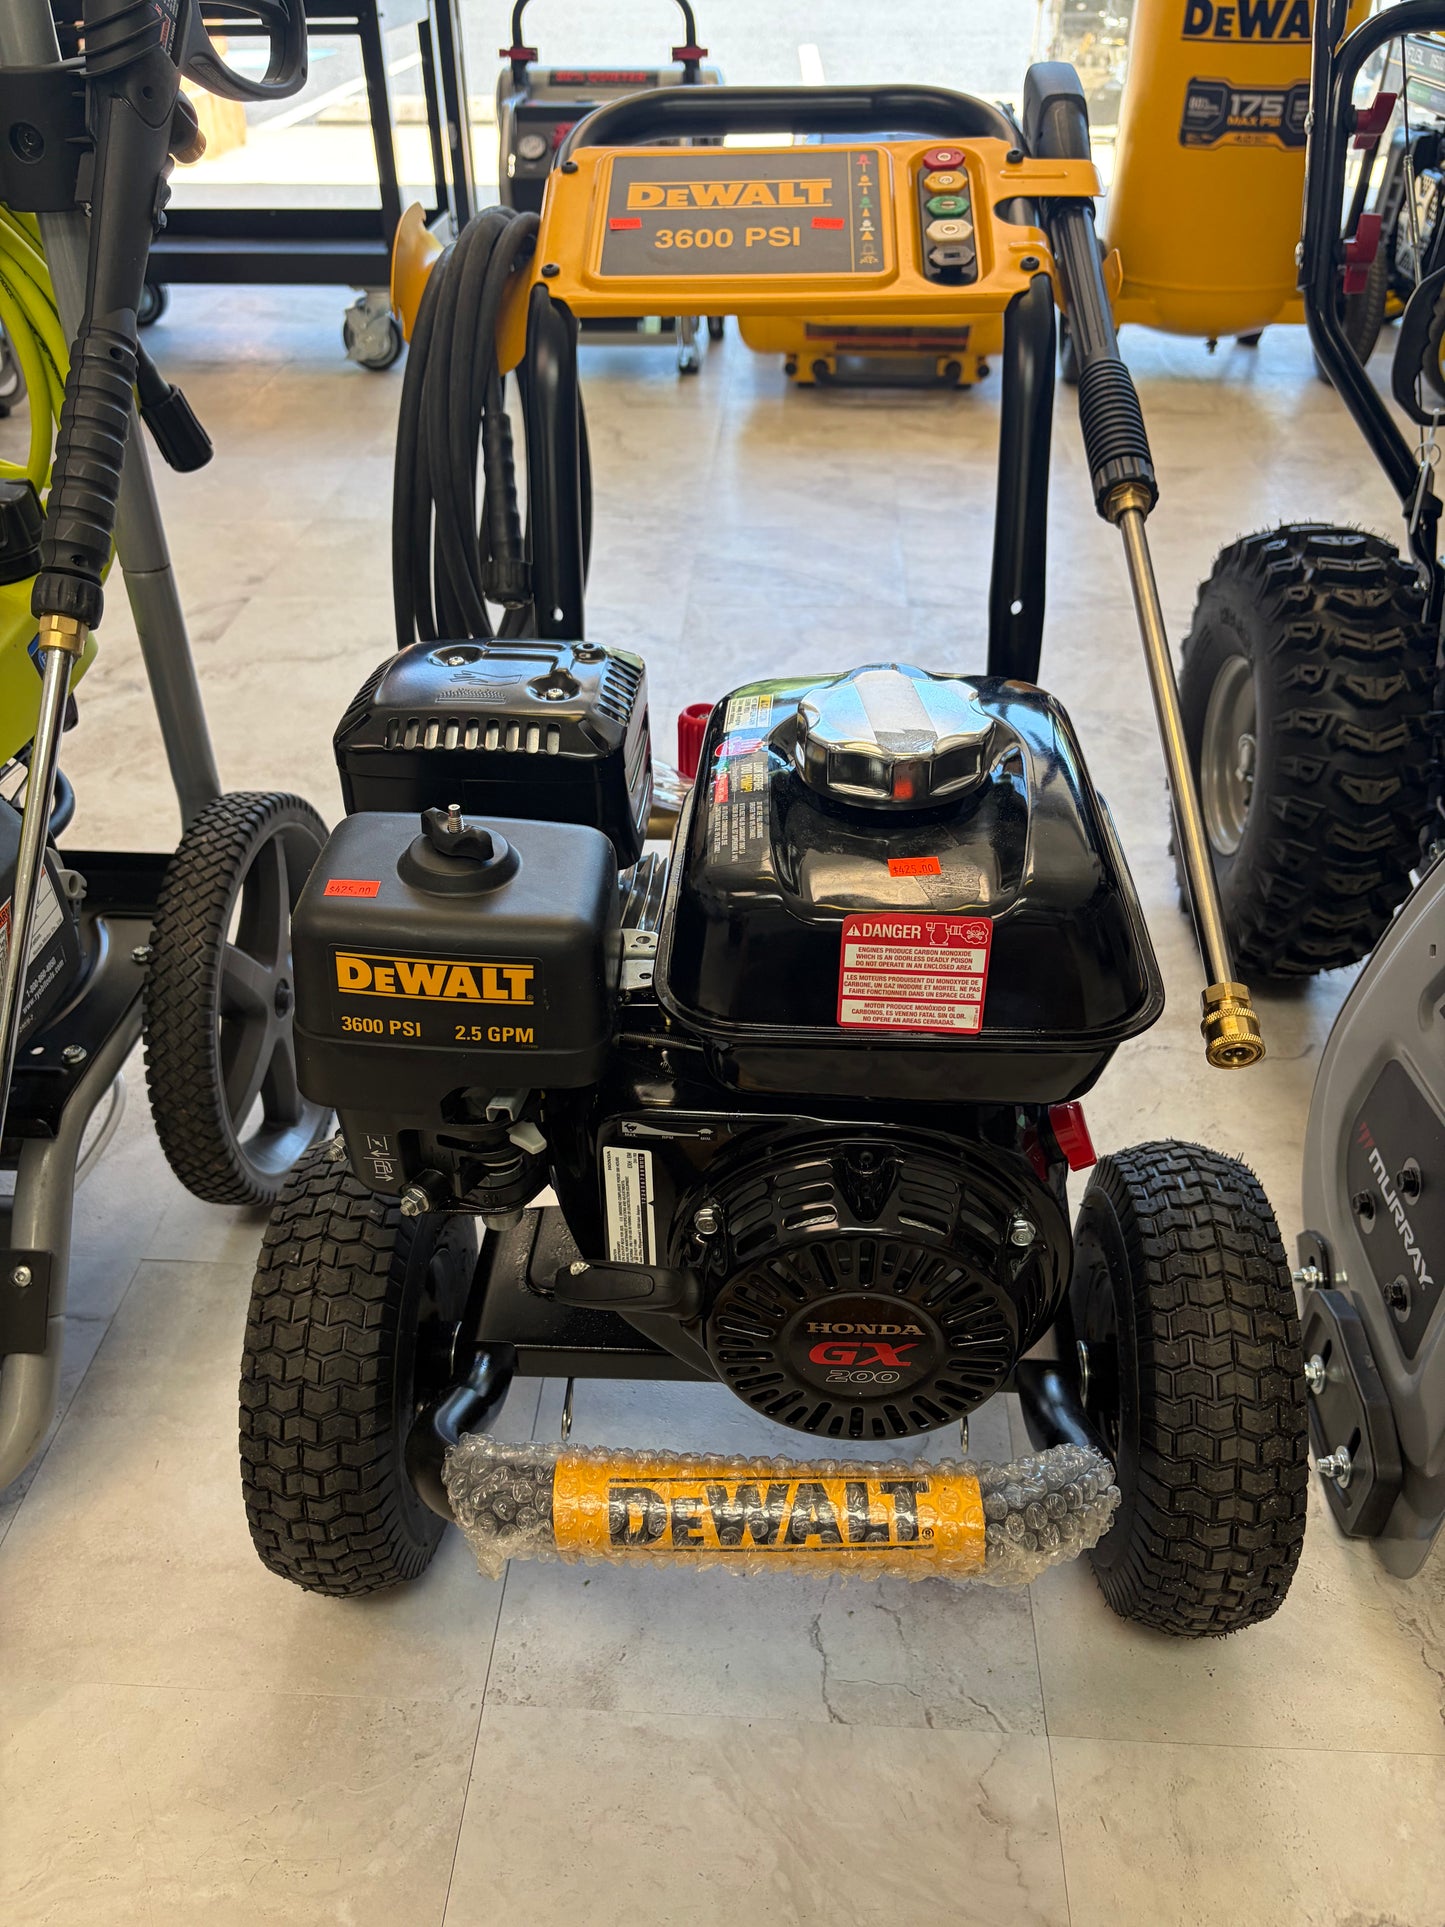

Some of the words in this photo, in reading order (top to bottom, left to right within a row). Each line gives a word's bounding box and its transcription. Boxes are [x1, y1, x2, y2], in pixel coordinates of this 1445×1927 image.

[1183, 0, 1311, 38] DEWA
[1231, 95, 1285, 117] 175
[1227, 116, 1258, 126] MAX
[1260, 117, 1282, 127] PSI
[627, 181, 832, 207] DEWALT
[654, 229, 734, 249] 3600
[745, 227, 801, 248] PSI
[893, 864, 934, 875] $425.00
[329, 885, 371, 895] $425.00
[862, 923, 921, 939] DANGER
[336, 957, 534, 1000] DEWALT
[341, 1015, 384, 1034] 3600
[389, 1020, 421, 1037] PSI
[455, 1025, 482, 1041] 2.5
[487, 1027, 534, 1043] GPM
[1368, 1147, 1434, 1285] MURRAY
[807, 1322, 926, 1336] HONDA
[808, 1341, 920, 1367] GX
[825, 1370, 900, 1384] 200
[608, 1481, 929, 1546] DEWALT
